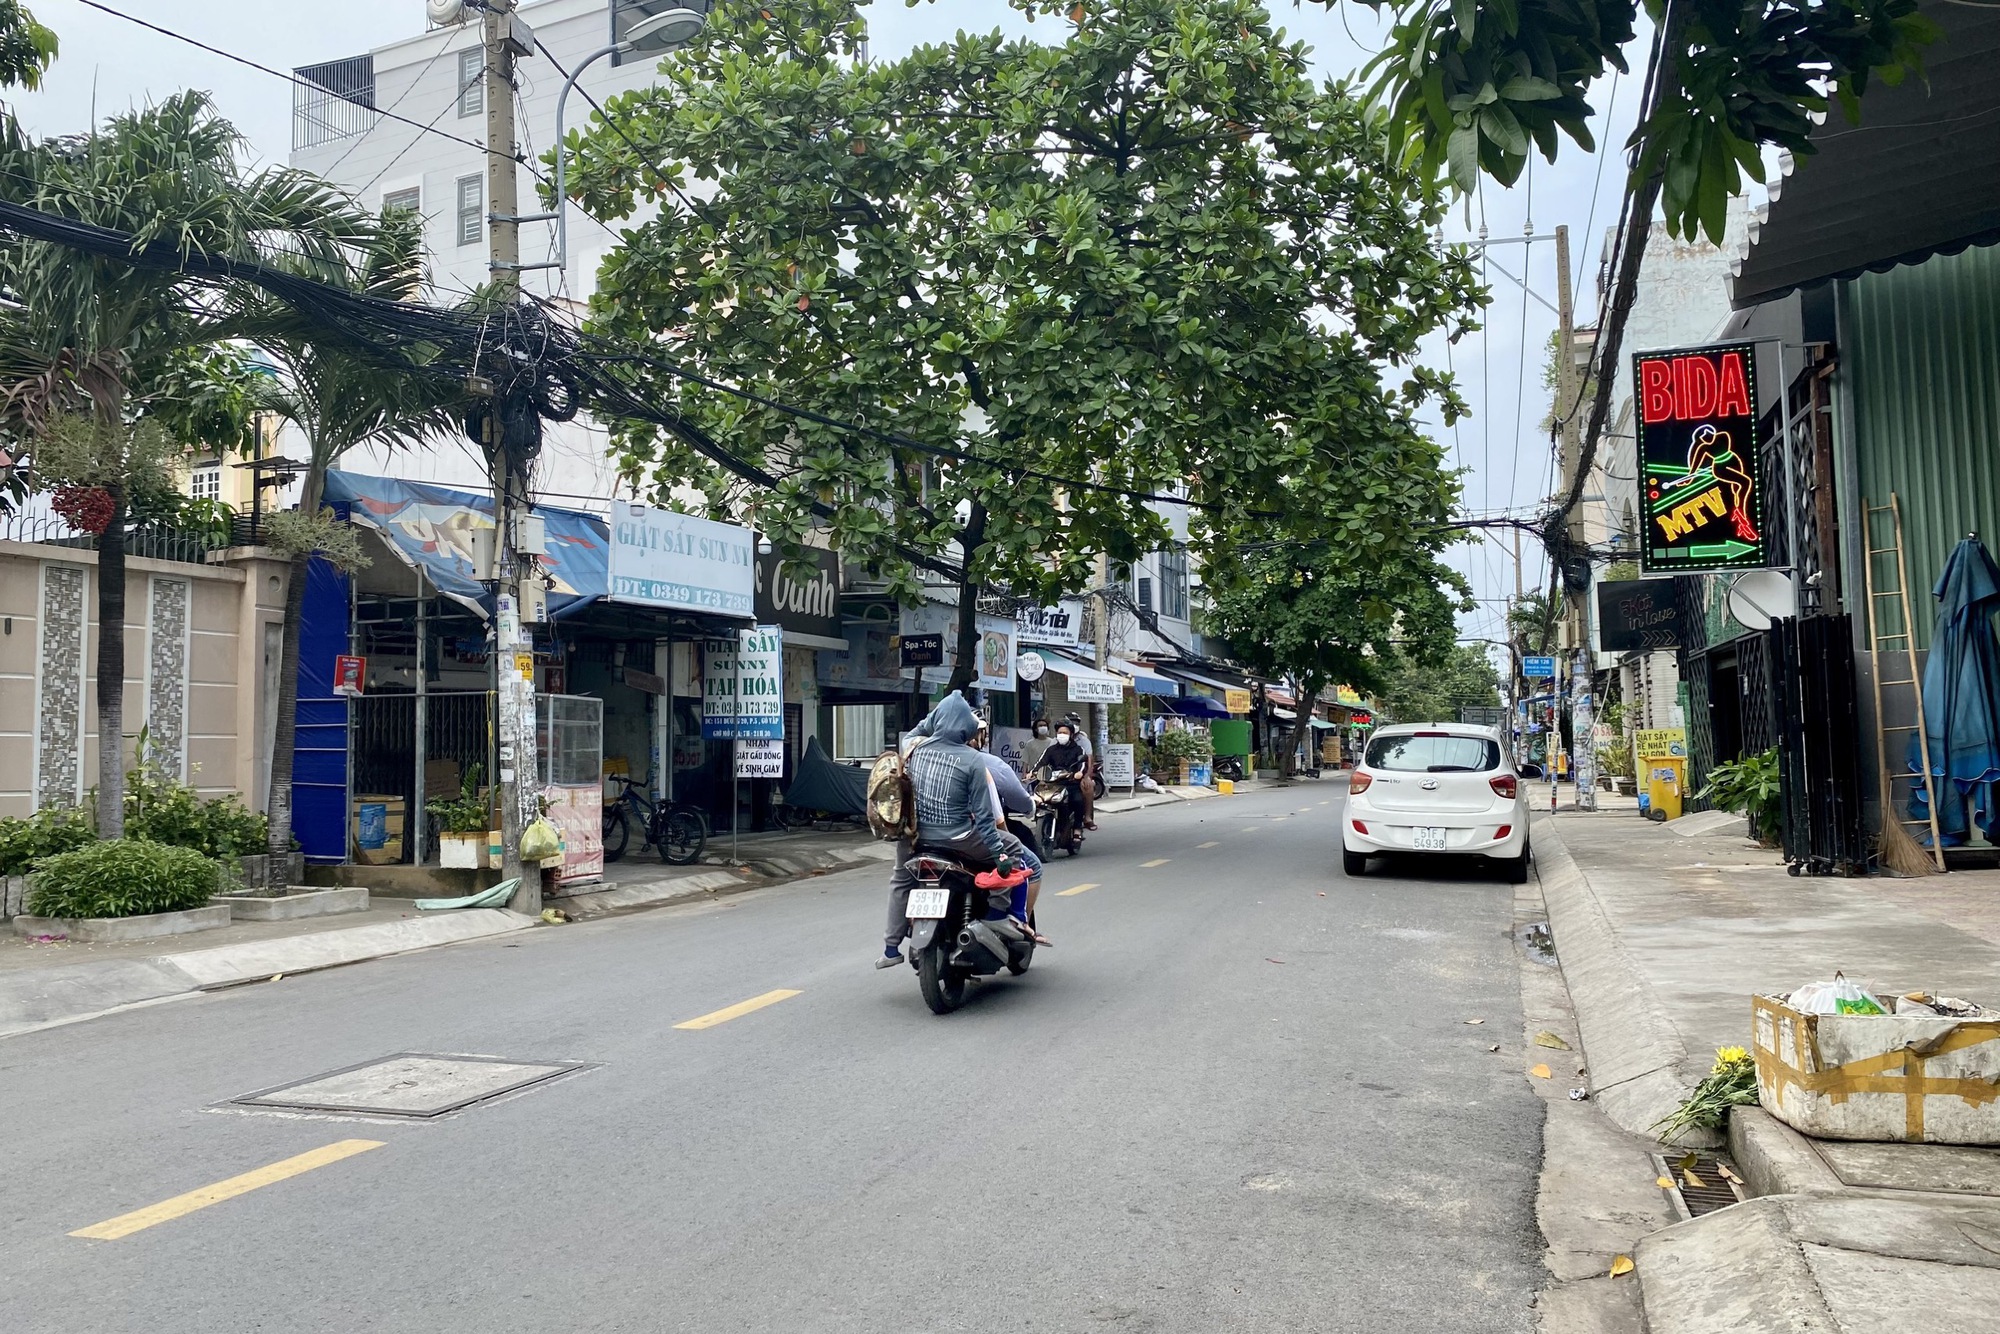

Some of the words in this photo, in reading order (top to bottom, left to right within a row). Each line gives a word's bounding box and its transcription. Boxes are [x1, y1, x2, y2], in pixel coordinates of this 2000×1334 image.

[1640, 353, 1749, 423] BIDA
[1656, 486, 1728, 542] MTV
[651, 583, 690, 601] 0349
[695, 589, 722, 607] 173
[725, 594, 751, 611] 739
[747, 630, 778, 653] SẤY
[904, 640, 919, 650] Spa
[713, 660, 769, 671] SUNNY
[742, 672, 778, 696] HÓA
[745, 702, 761, 715] 173
[763, 702, 779, 714] 739
[745, 764, 762, 773] SINH
[1420, 829, 1438, 838] 51F
